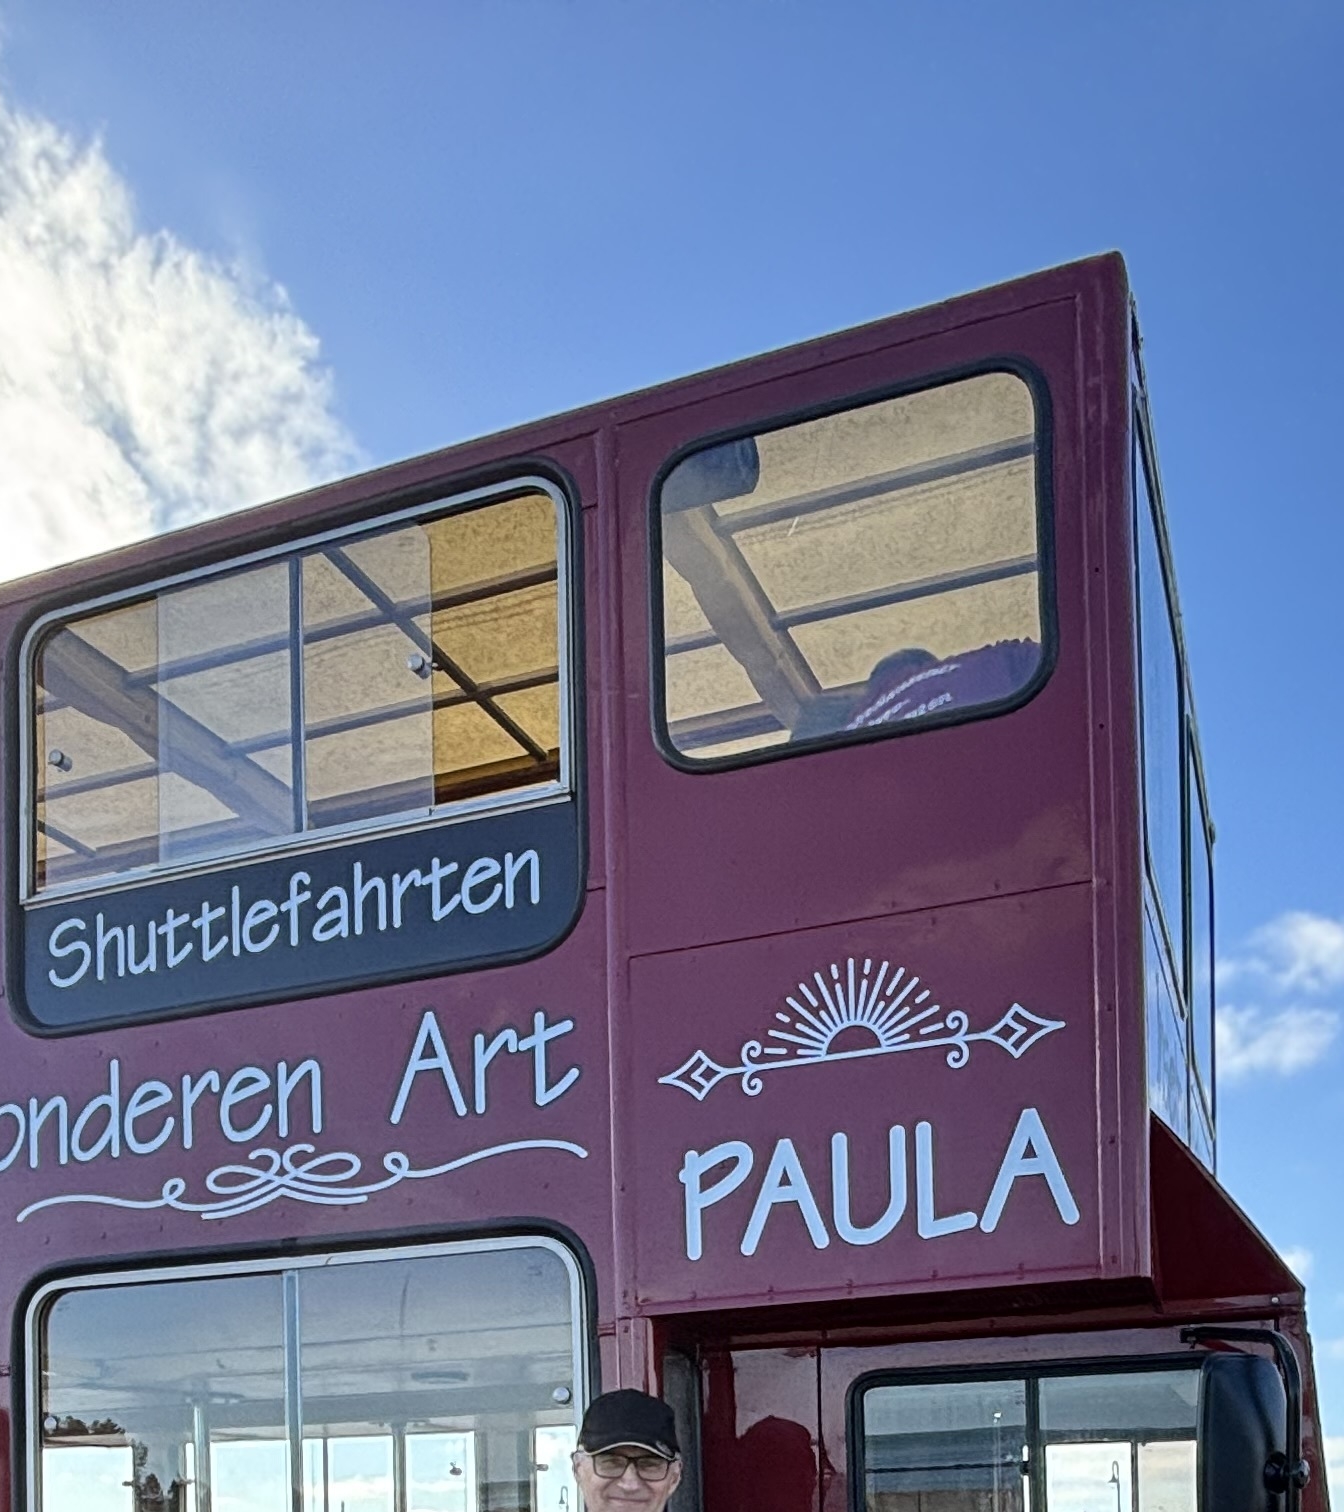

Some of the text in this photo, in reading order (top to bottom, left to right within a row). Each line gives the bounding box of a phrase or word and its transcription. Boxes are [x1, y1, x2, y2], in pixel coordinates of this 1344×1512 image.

[47, 847, 541, 989] Shuttlefahrten
[389, 1009, 582, 1126] Art
[678, 1107, 1082, 1262] PAULA
